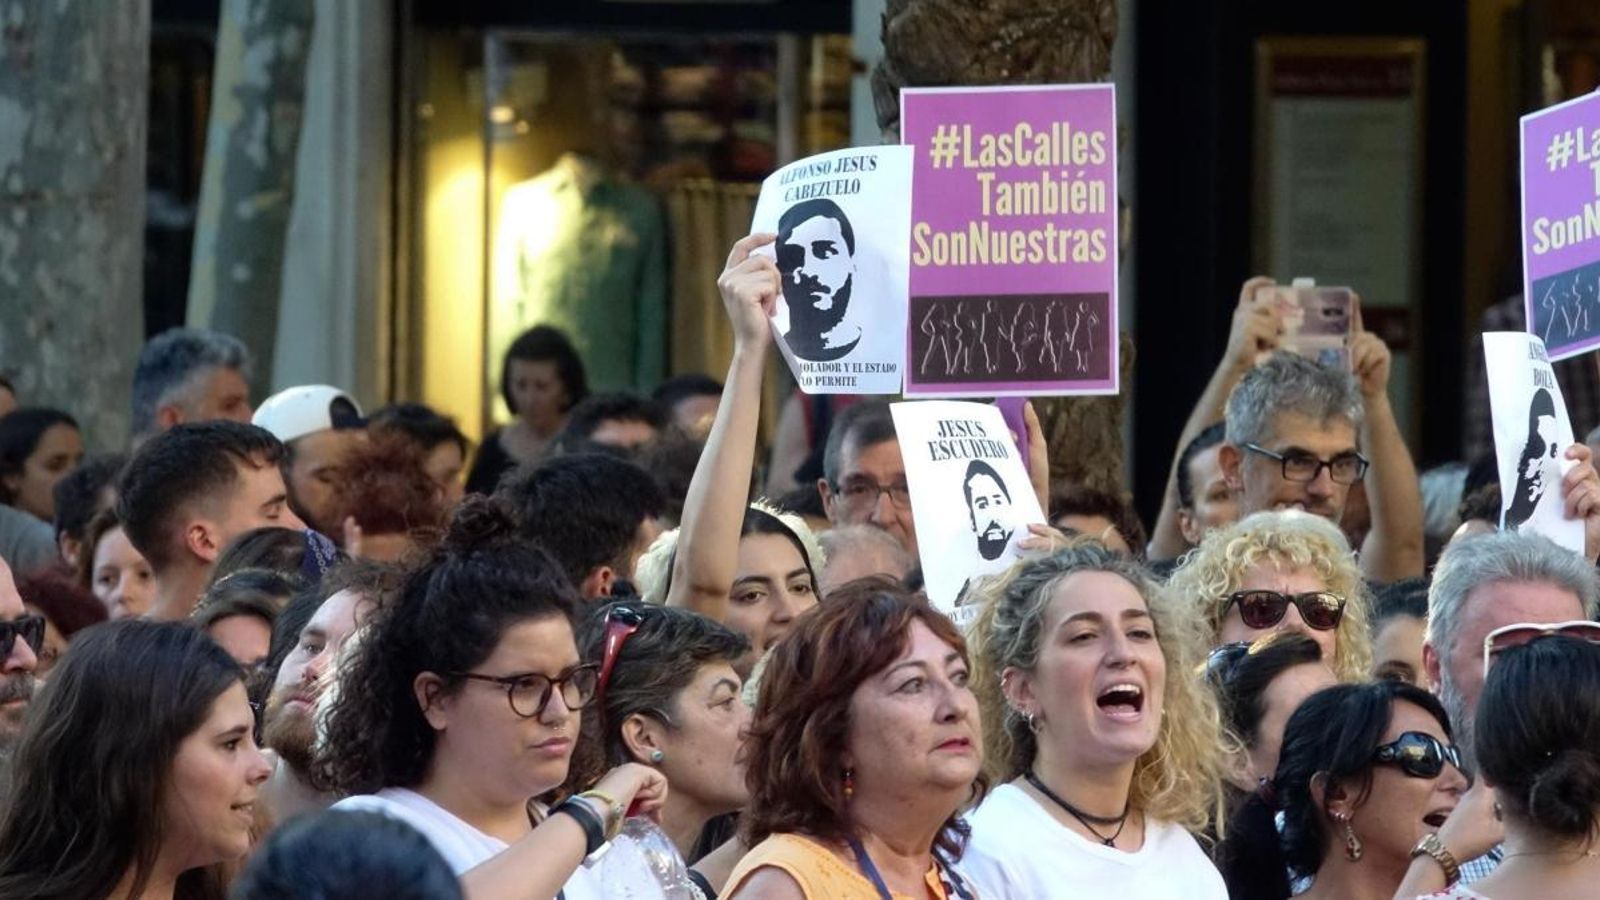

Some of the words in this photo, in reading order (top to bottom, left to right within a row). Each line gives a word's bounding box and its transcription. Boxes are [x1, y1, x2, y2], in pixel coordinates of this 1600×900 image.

[929, 122, 1107, 170] #LasCalles
[780, 160, 832, 185] ALFONSO
[834, 155, 878, 173] JESUS
[784, 178, 861, 202] CABEZUELO
[977, 171, 1106, 216] También
[912, 221, 1107, 266] SonNuestras
[843, 362, 851, 373] Y
[852, 362, 863, 373] EL
[864, 362, 897, 373] ESTADO
[815, 375, 857, 386] PERMITE
[937, 419, 987, 438] JESUS
[927, 438, 1009, 461] ESCUDERO
